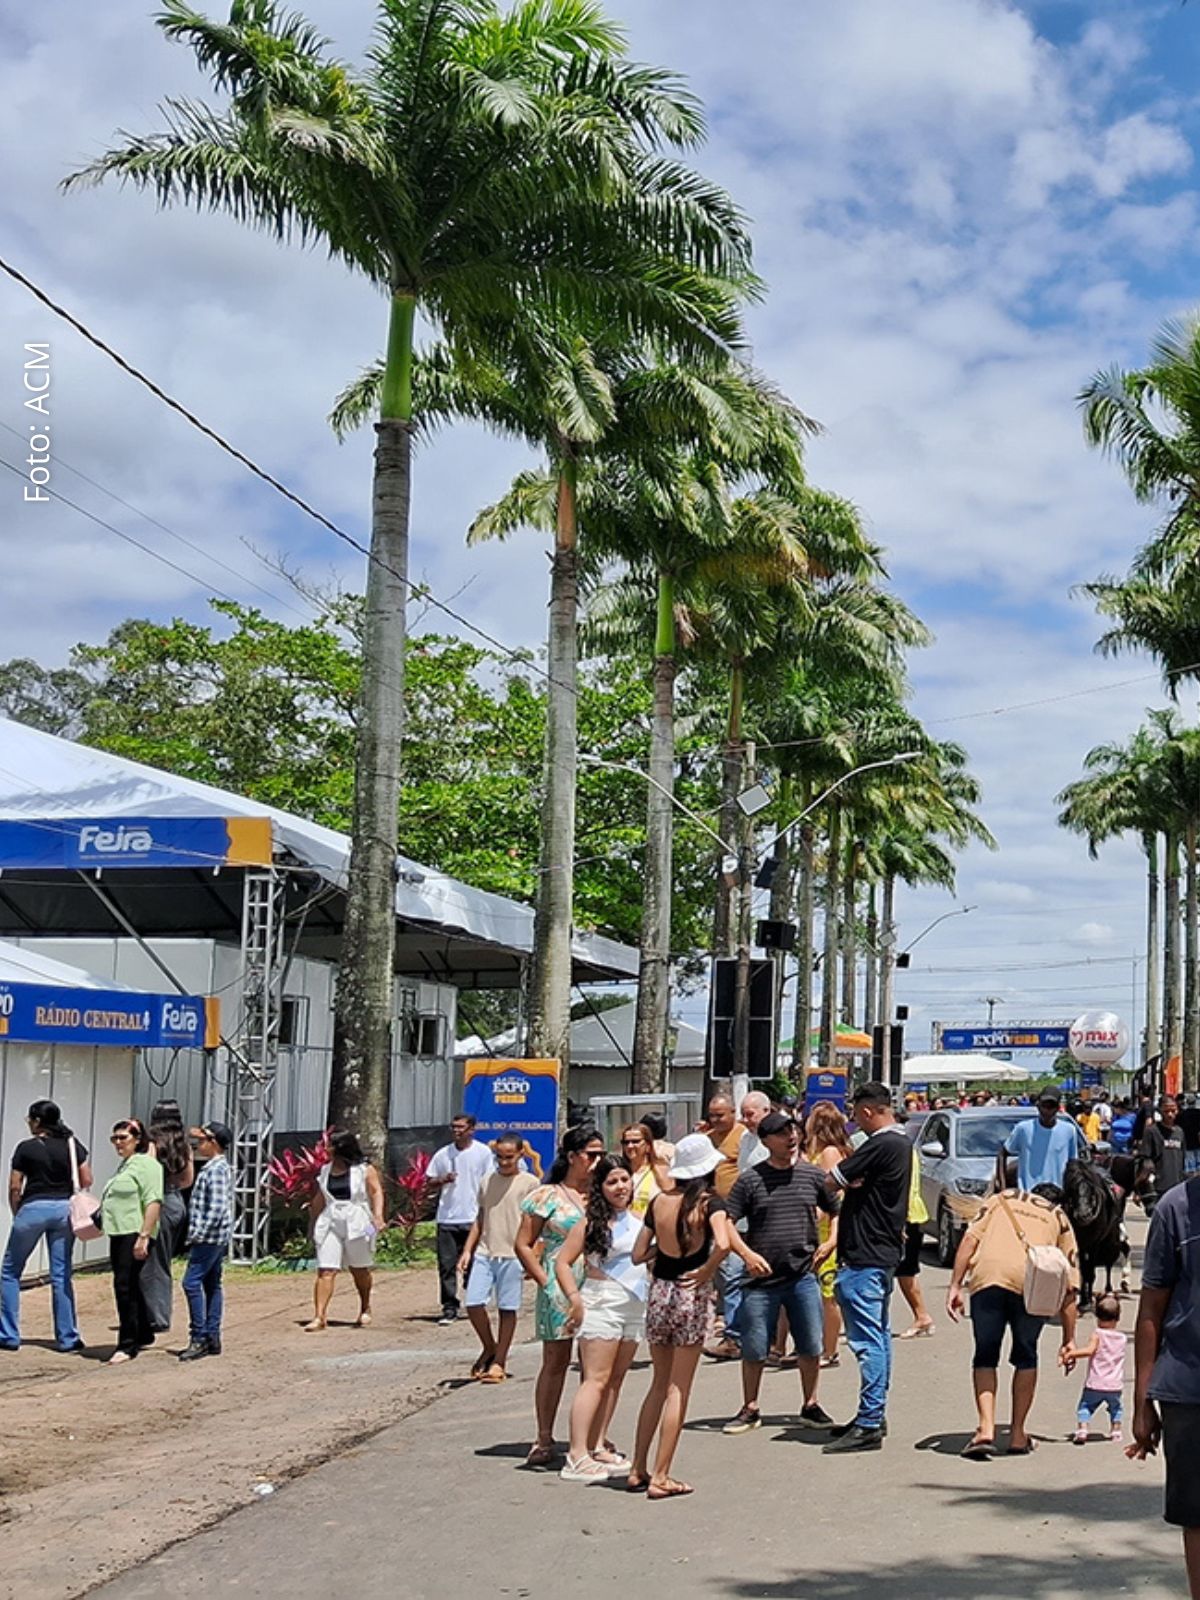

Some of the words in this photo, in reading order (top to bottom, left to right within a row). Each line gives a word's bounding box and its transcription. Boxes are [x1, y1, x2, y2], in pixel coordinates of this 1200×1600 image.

[78, 825, 153, 853] Feira
[35, 1002, 80, 1027] RÁDIO
[83, 1009, 144, 1030] CENTRAL
[160, 1002, 199, 1031] Feira
